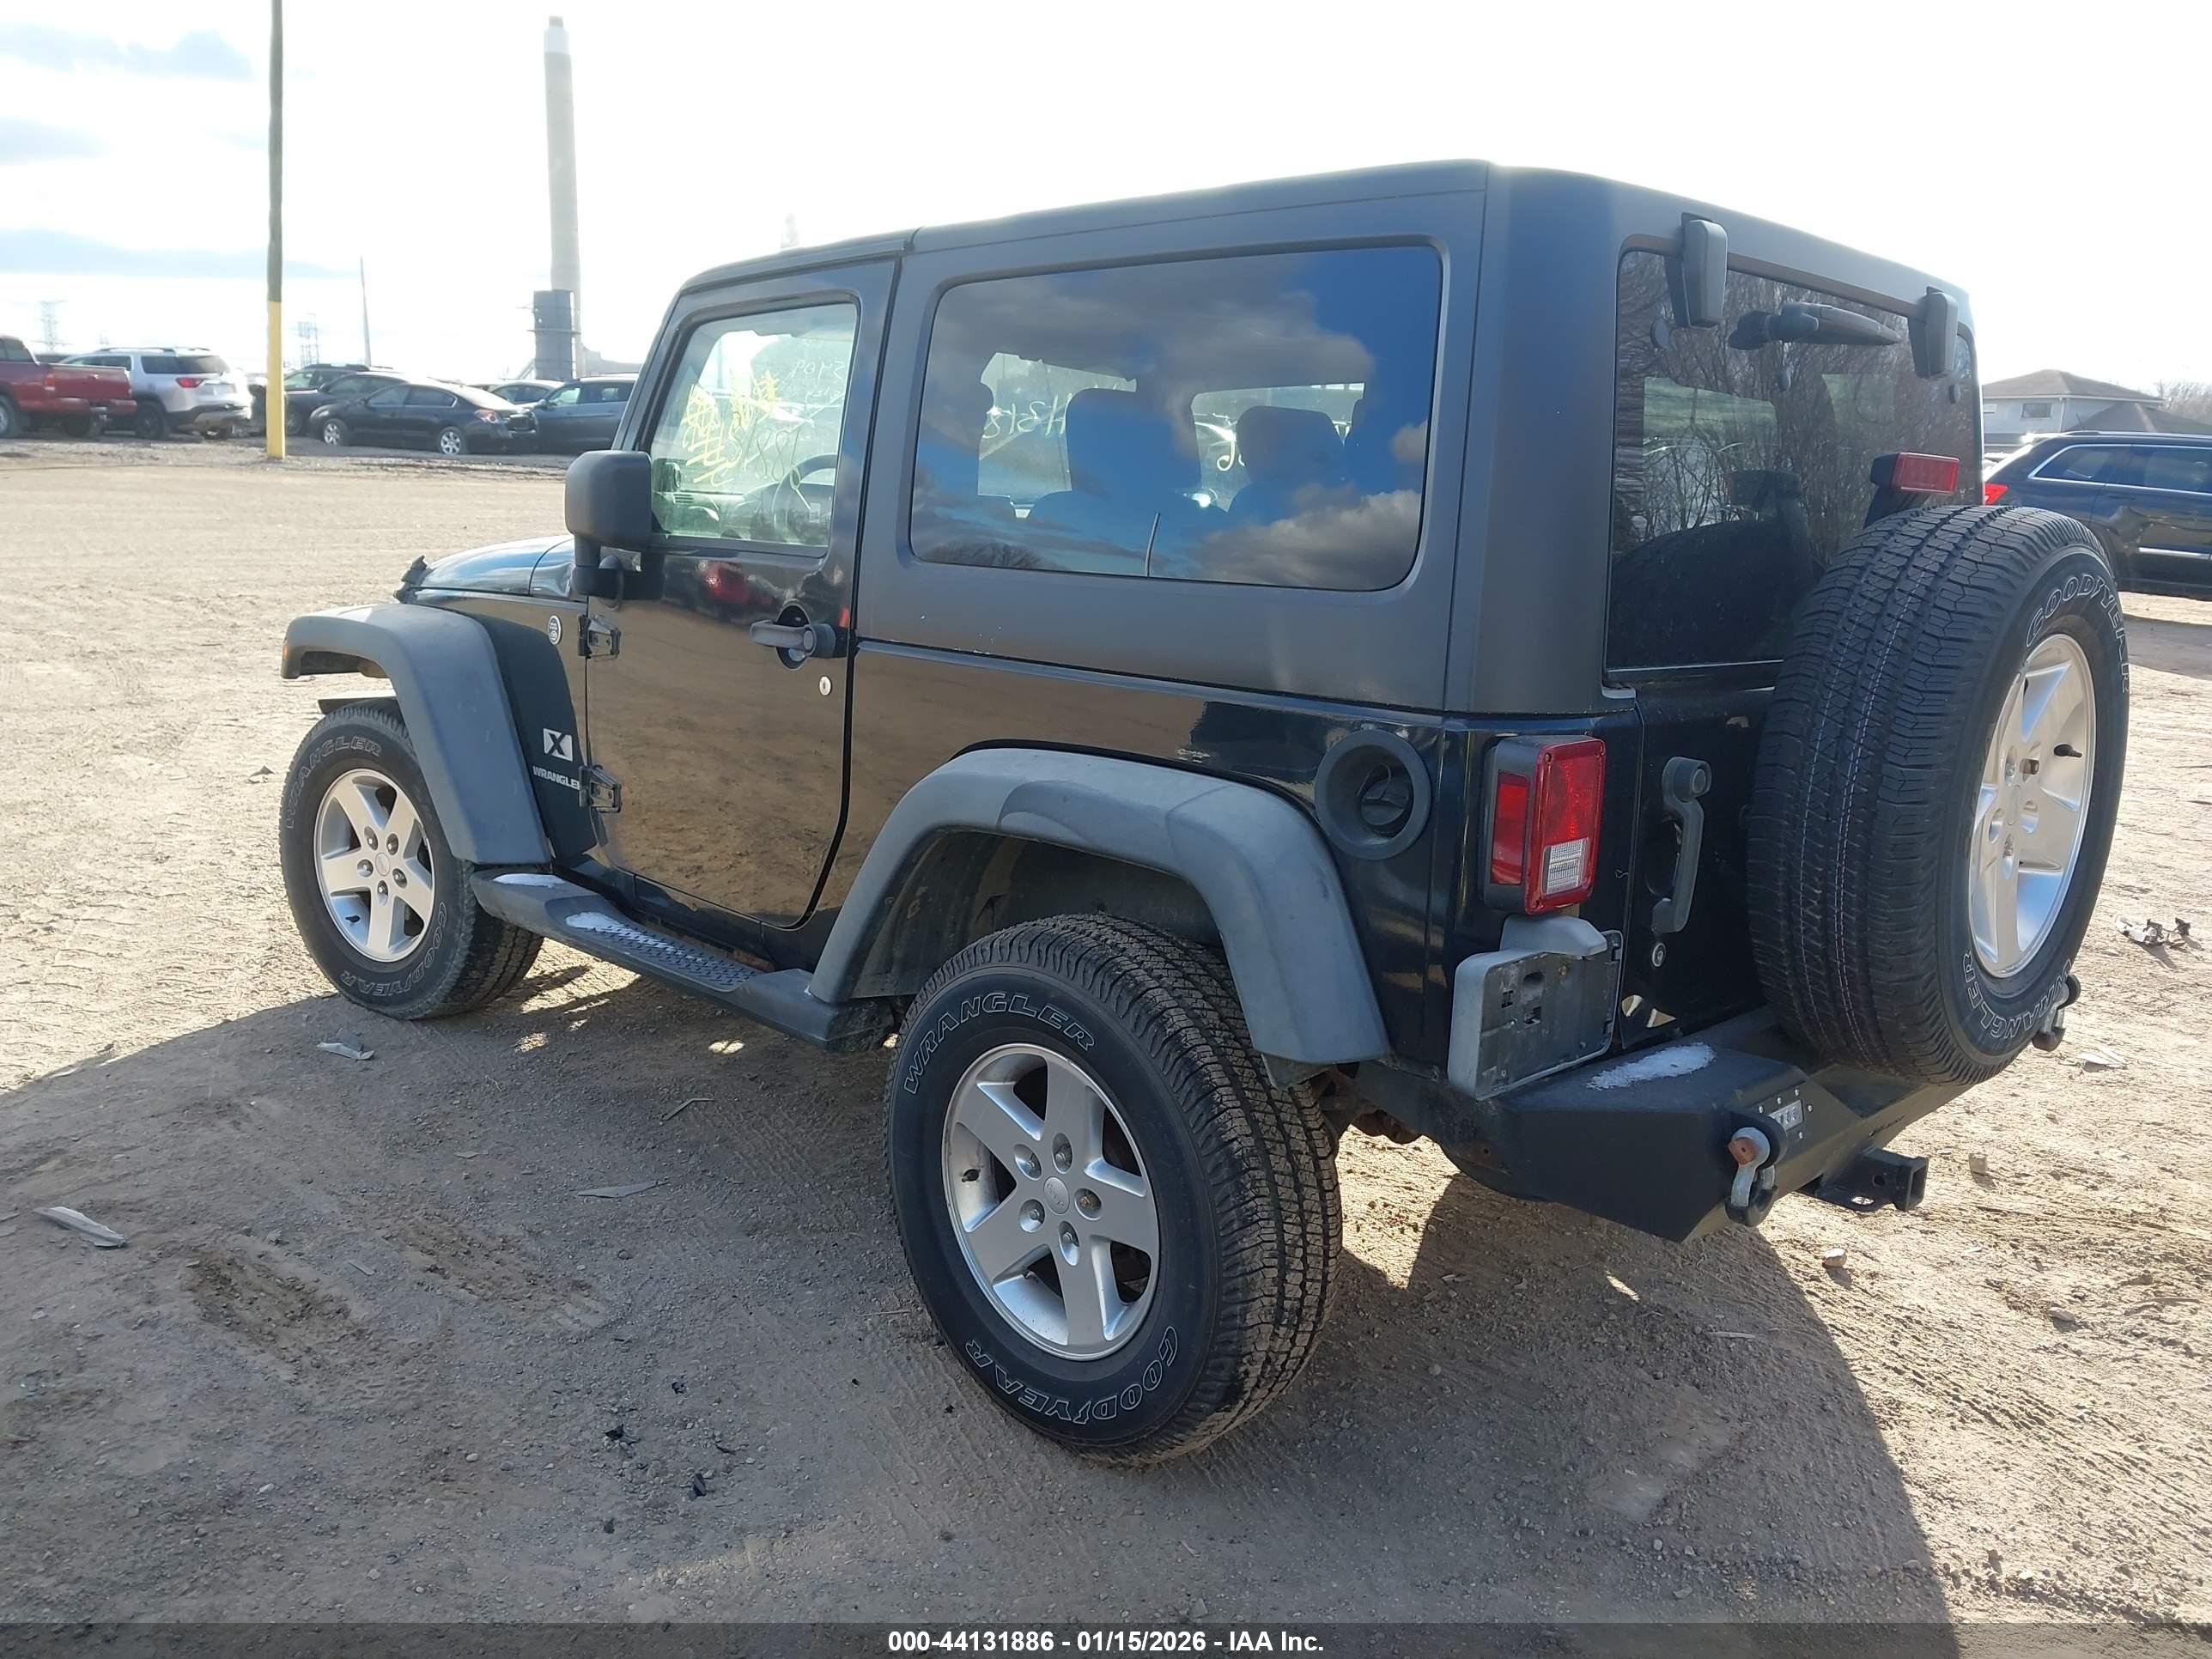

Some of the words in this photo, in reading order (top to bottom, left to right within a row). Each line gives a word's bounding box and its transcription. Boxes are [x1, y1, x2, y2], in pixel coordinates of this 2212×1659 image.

[2027, 574, 2130, 694] GOODYEAR
[286, 735, 382, 830] WRANGLER
[341, 900, 447, 998] GOODYEAR
[903, 992, 1096, 1095] WRANGLER
[965, 1326, 1179, 1425] GOODYEAR
